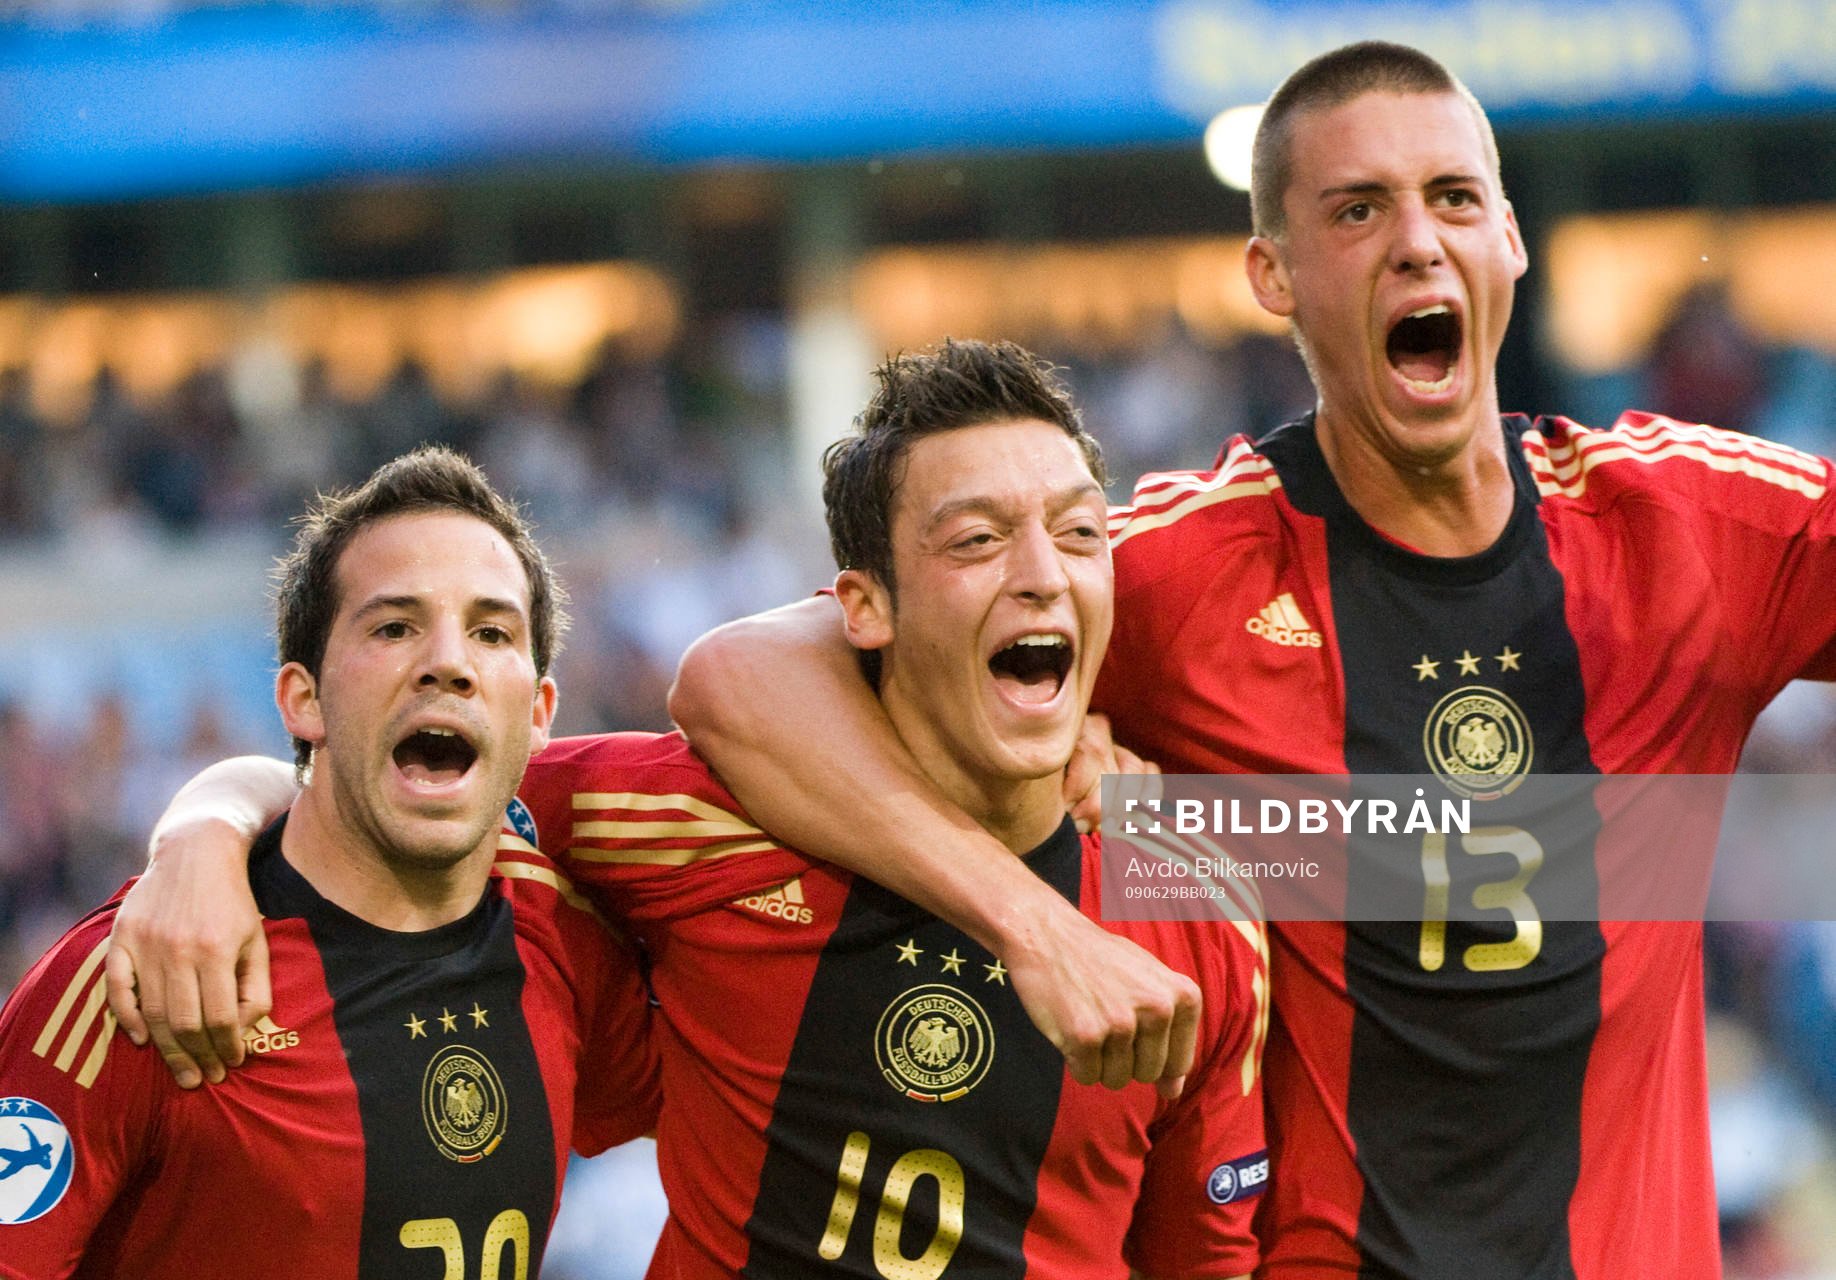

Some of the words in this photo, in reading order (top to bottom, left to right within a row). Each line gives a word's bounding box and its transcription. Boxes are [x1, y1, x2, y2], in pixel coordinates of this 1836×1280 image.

[1245, 616, 1323, 649] adidas
[1419, 825, 1544, 972] 13
[908, 998, 973, 1027] DEUTSCHER
[246, 1030, 301, 1054] idas
[893, 1047, 970, 1085] FUSSBALL-BUND
[817, 1131, 965, 1280] 10
